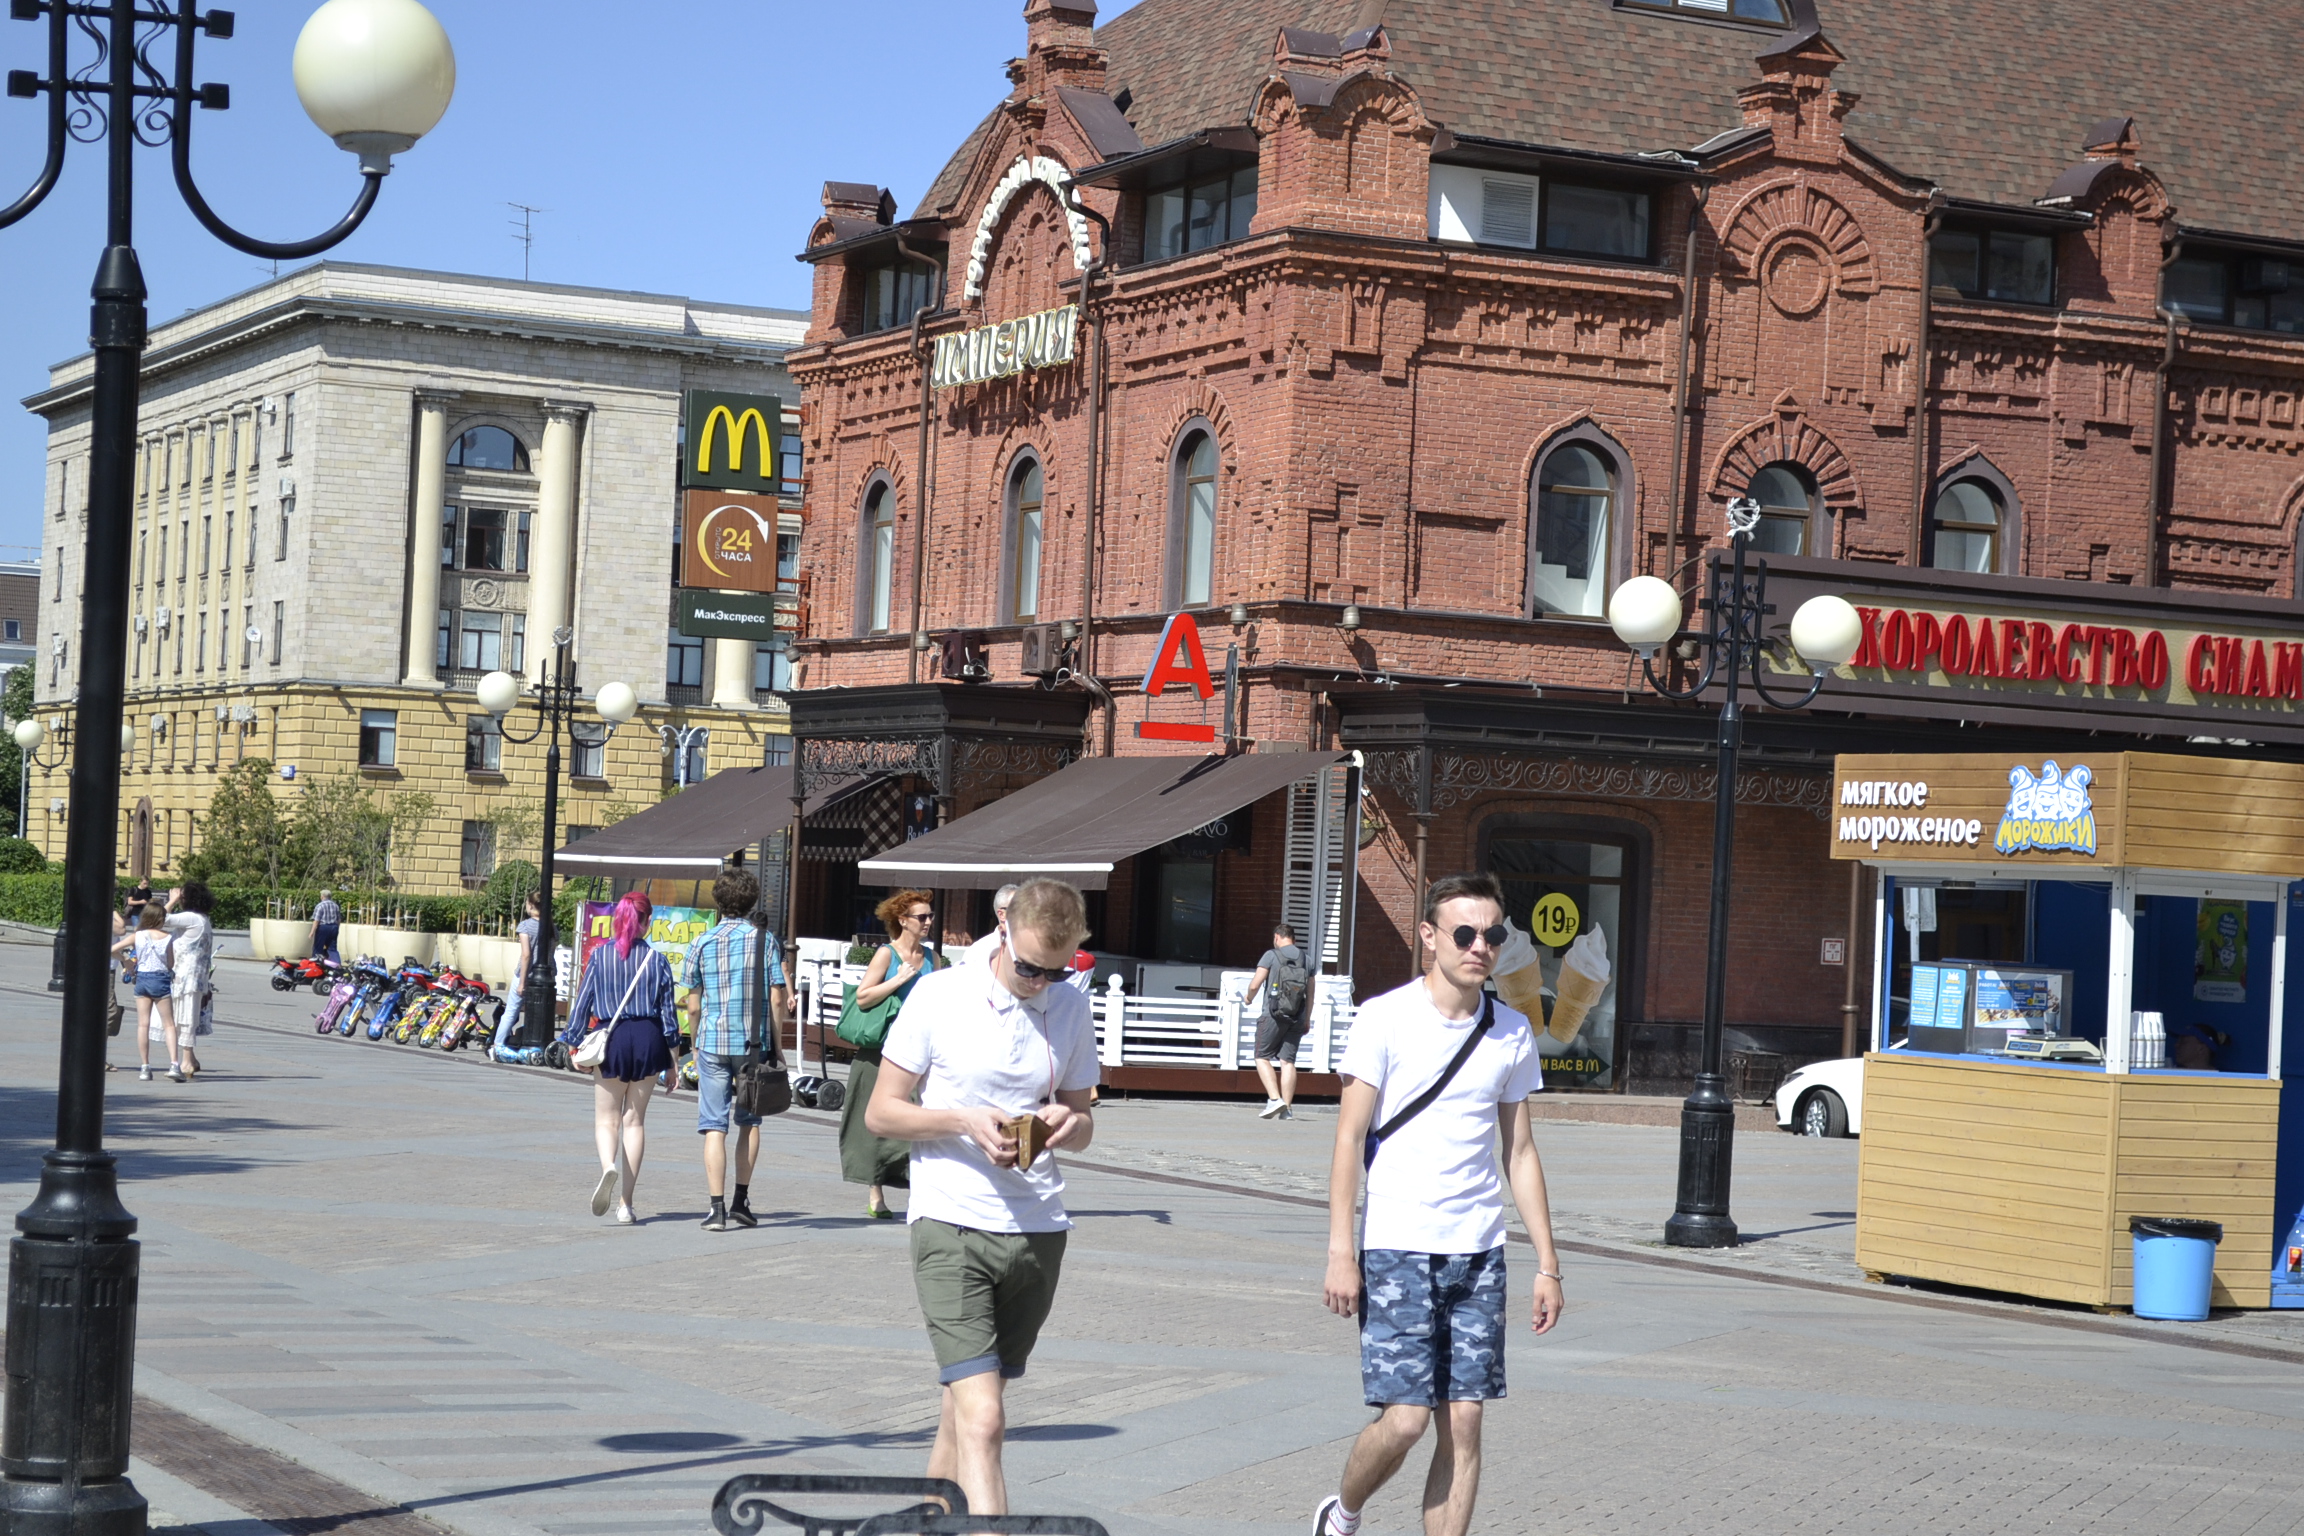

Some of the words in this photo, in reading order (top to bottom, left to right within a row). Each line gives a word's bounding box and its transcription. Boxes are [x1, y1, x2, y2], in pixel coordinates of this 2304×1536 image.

[721, 527, 753, 552] 24
[720, 551, 752, 562] ЧАСА
[693, 608, 766, 624] МакЭкспресс
[1848, 606, 2168, 691] КОРОЛЕВСТВО
[1840, 780, 1928, 806] мягкое
[1838, 815, 1982, 851] мороженое
[1996, 814, 2093, 849] МОРОЖИКИ
[590, 915, 707, 944] ПКАТ
[1551, 1058, 1573, 1071] ВАС
[1575, 1058, 1584, 1072] В
